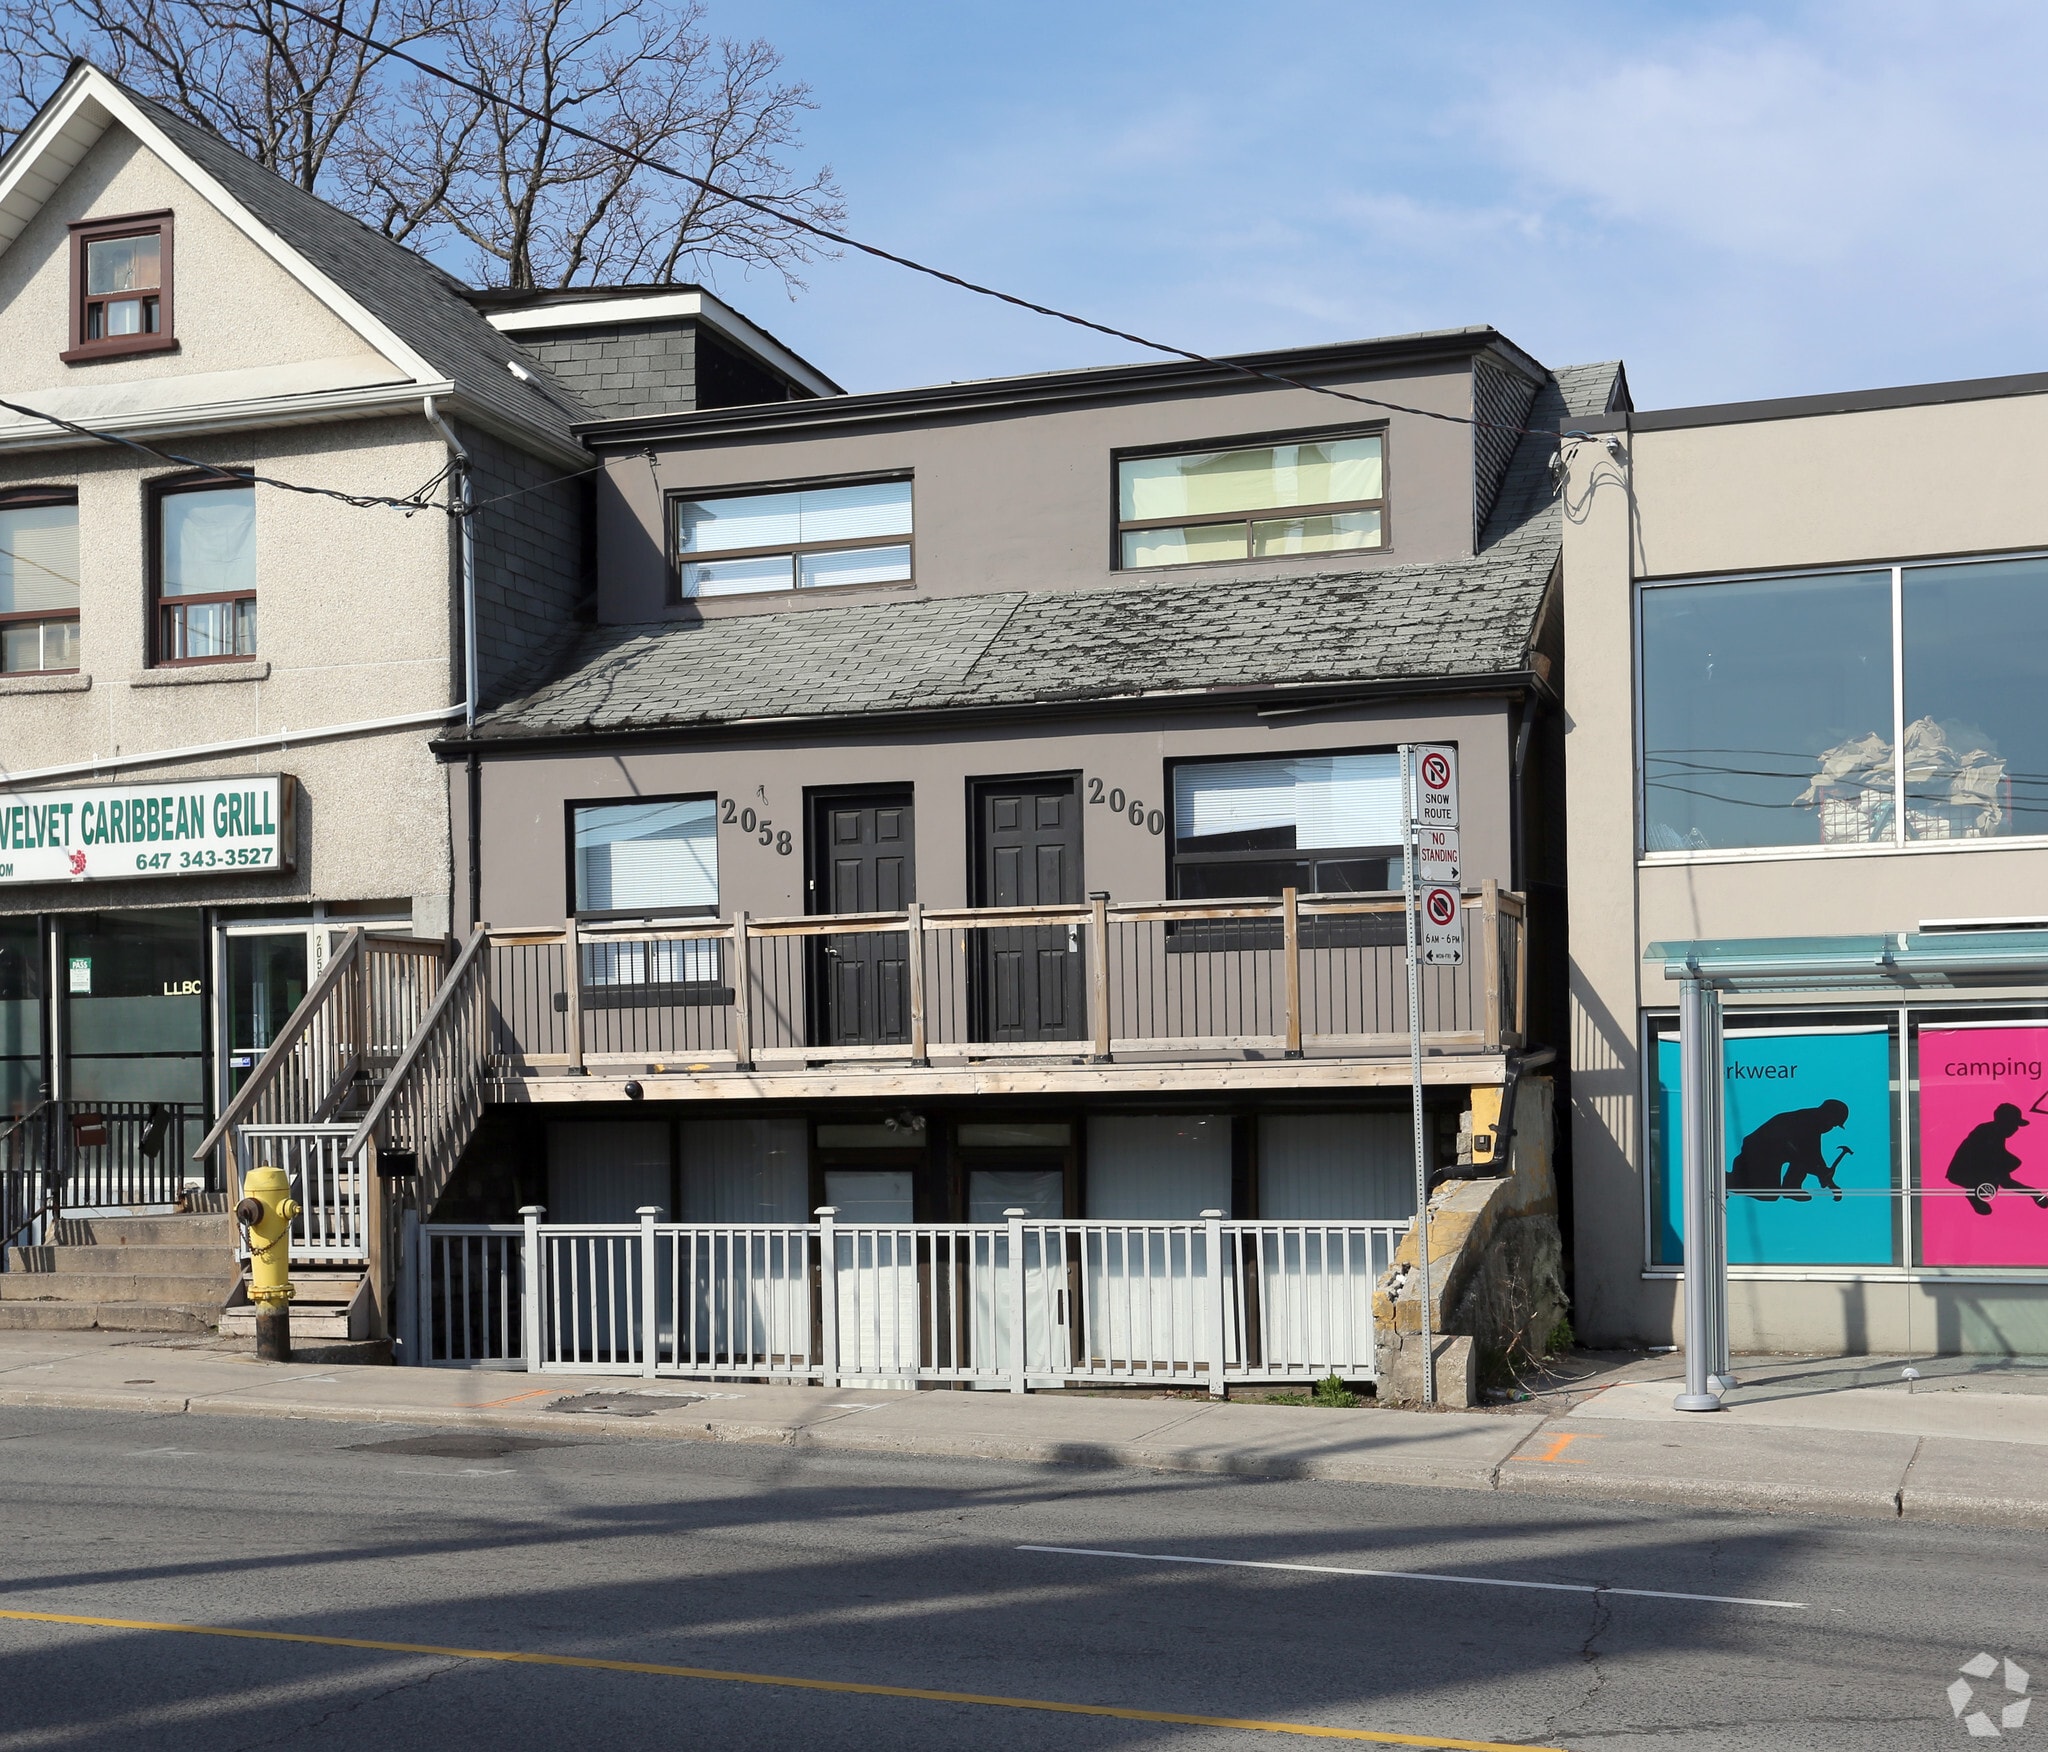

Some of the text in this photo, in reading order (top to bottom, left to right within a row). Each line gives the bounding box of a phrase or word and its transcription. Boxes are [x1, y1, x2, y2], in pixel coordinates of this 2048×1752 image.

[1087, 777, 1164, 836] 2060
[1425, 793, 1450, 805] SNOW
[0, 791, 276, 850] VELVET CARIBBEAN GRILL
[1424, 807, 1452, 819] ROUTE
[721, 798, 793, 856] 2058
[1432, 832, 1446, 846] NO
[136, 847, 274, 870] 647 343-3527
[1421, 848, 1458, 863] STANDING
[72, 961, 88, 969] PASS
[1724, 1060, 1798, 1080] rkwear
[1944, 1057, 2042, 1081] camping
